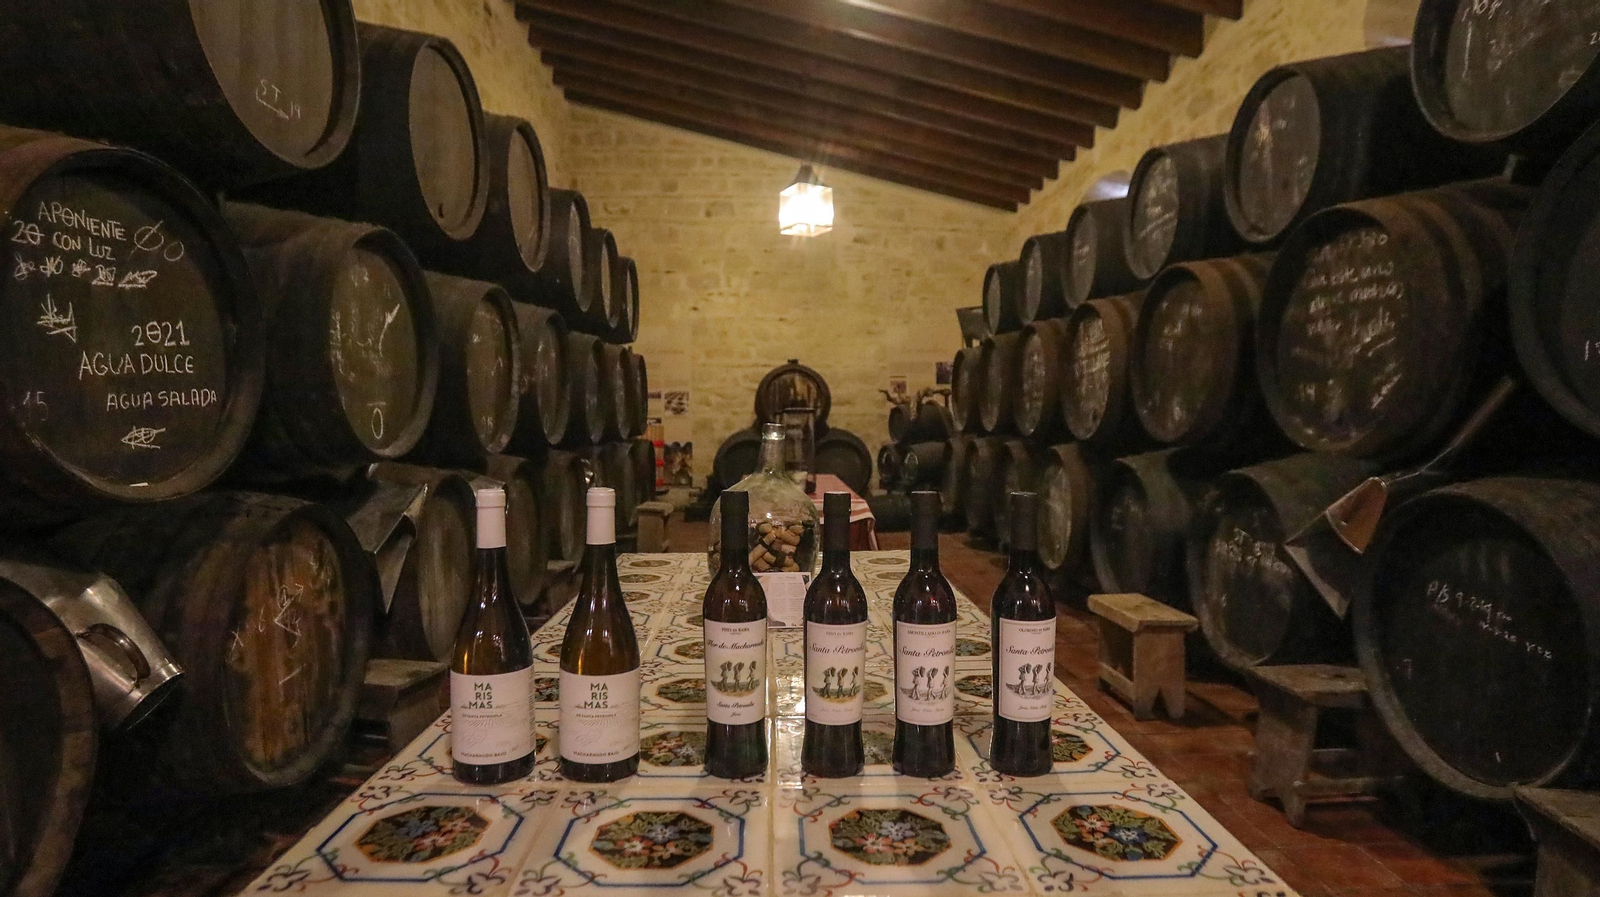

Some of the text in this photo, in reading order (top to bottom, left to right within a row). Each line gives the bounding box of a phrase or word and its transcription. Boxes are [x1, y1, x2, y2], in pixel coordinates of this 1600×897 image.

[38, 201, 127, 242] APONIENTE
[52, 231, 82, 250] CON
[88, 237, 116, 261] LUZ
[131, 319, 190, 347] 2021
[79, 351, 195, 380] AGUA DULCE
[106, 388, 218, 412] AGUA SALADA
[809, 643, 830, 654] Santa
[899, 646, 921, 657] Santa
[1005, 645, 1027, 655] Santa
[474, 682, 493, 691] MA
[590, 682, 609, 691] MA
[475, 692, 493, 700] RIS
[591, 692, 608, 700] RIS
[468, 701, 493, 710] MAS
[584, 701, 608, 709] MAS
